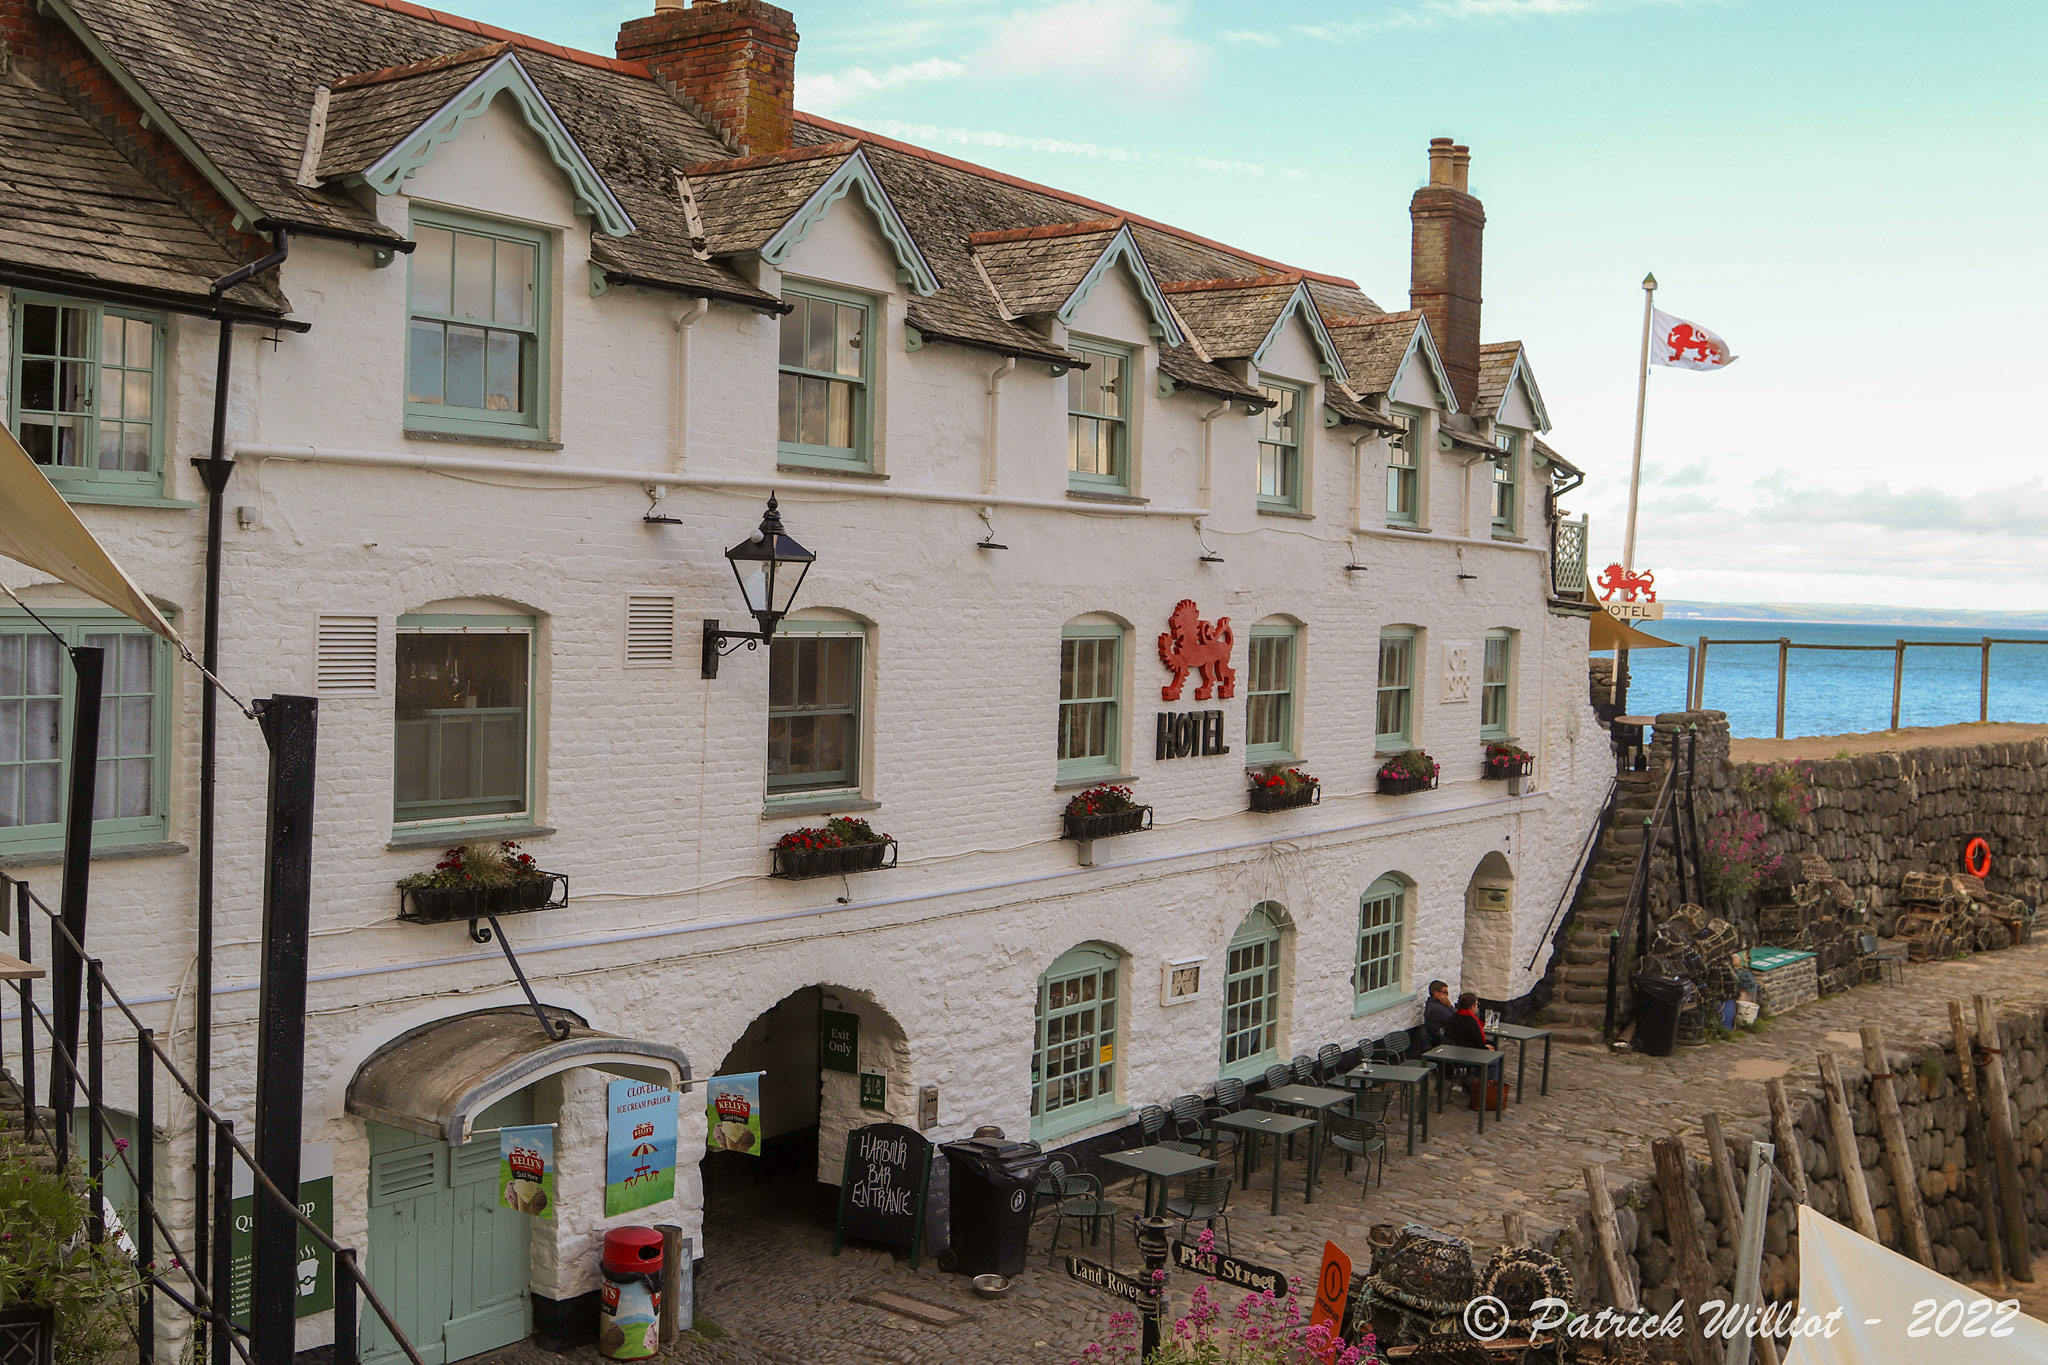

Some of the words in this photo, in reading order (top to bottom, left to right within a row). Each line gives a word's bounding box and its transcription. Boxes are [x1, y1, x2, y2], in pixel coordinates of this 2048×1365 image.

[1448, 648, 1468, 671] CH
[1156, 710, 1230, 760] HOTEL
[831, 1028, 850, 1040] Exit
[829, 1041, 852, 1056] Only
[617, 1105, 626, 1114] ICE
[627, 1100, 646, 1111] CREAM
[647, 1095, 671, 1107] PARLOUR
[718, 1101, 748, 1112] KELLY'S
[512, 1156, 541, 1169] KELLY'S
[860, 1132, 907, 1170] HARBOUR
[867, 1163, 892, 1194] BAR
[852, 1179, 914, 1216] ENTRANCE
[1073, 1258, 1102, 1284] Land
[1108, 1272, 1141, 1298] Rover
[1222, 1260, 1276, 1291] Street
